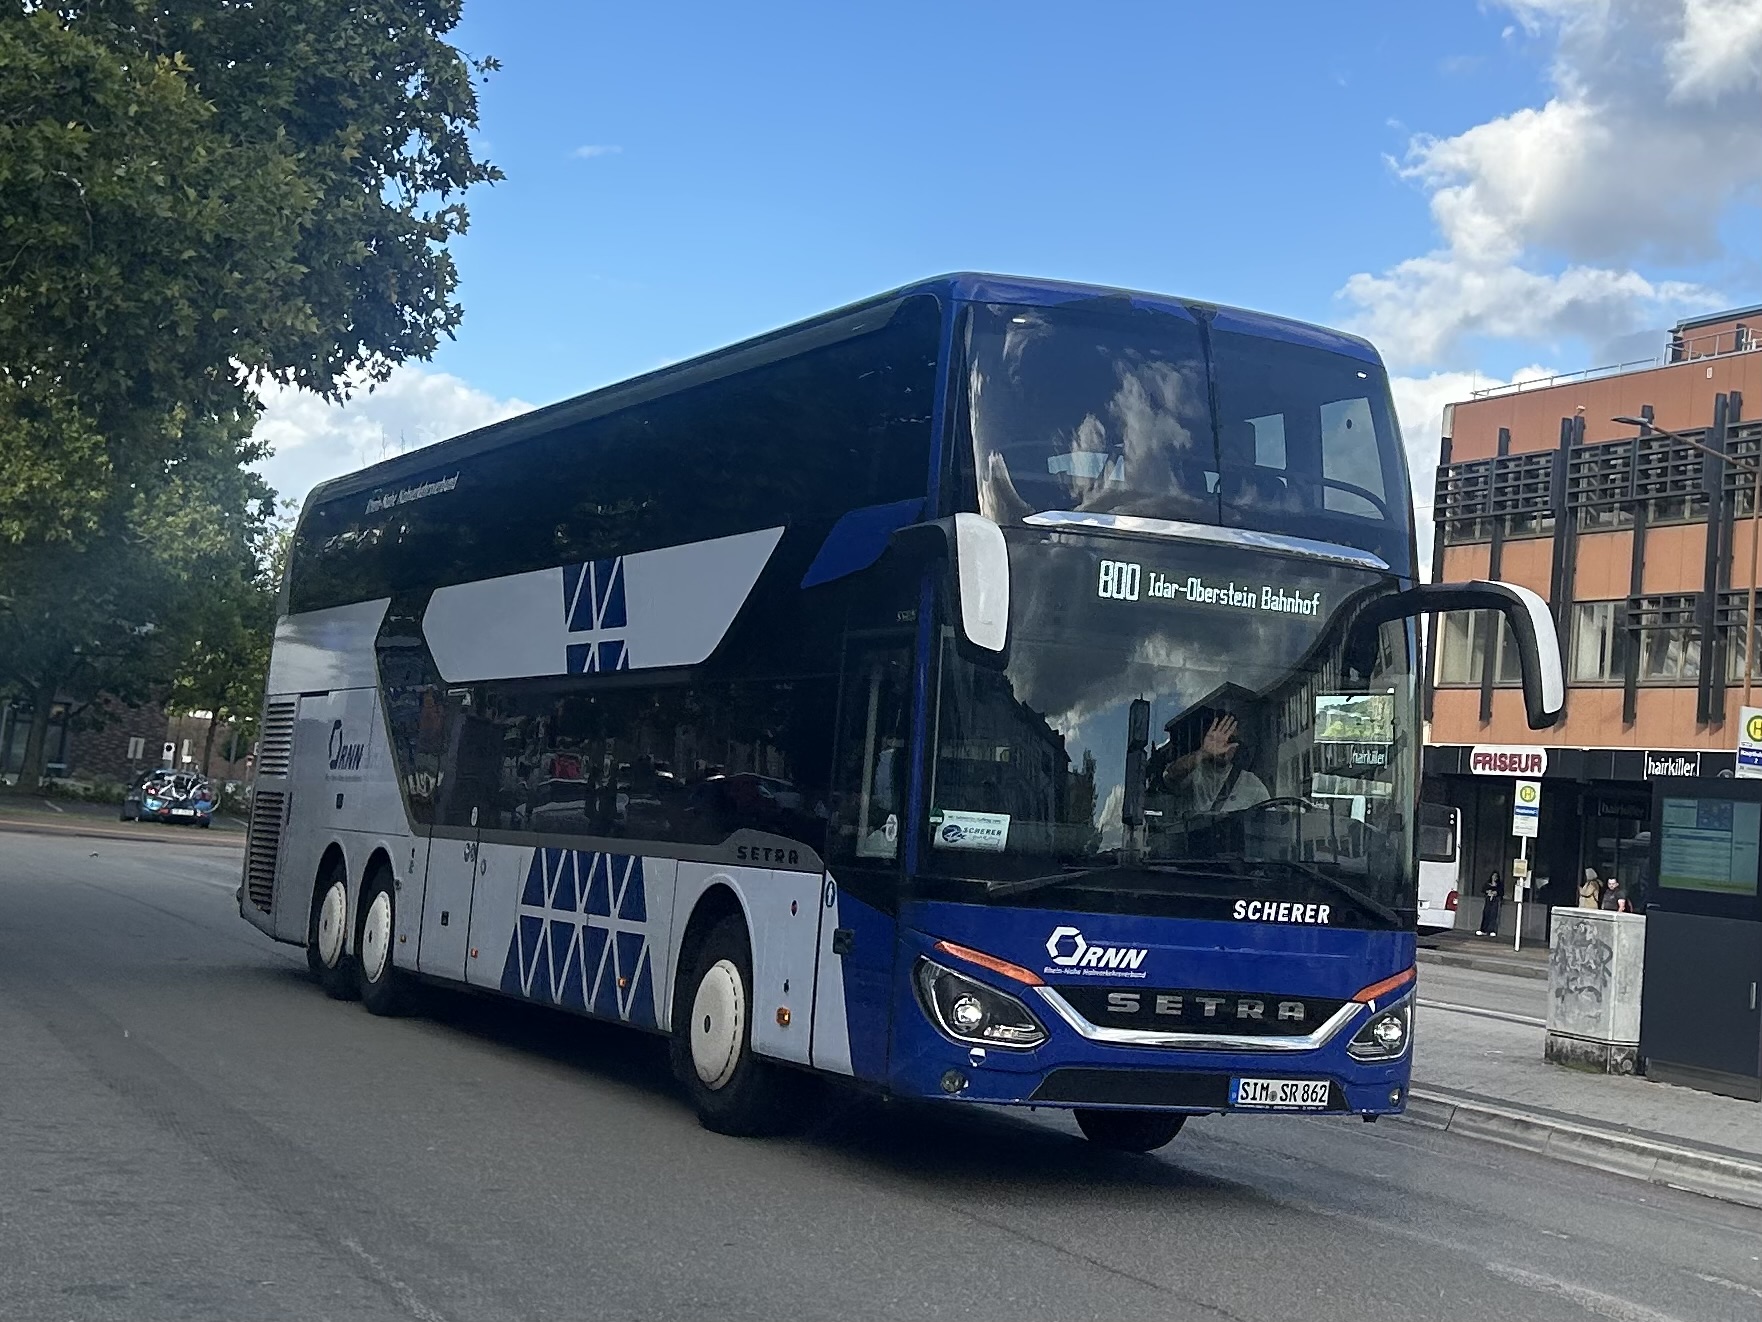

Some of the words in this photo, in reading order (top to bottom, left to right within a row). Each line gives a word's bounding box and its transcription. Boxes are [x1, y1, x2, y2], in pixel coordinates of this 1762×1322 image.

[1098, 560, 1141, 601] 800
[1148, 572, 1256, 609] Idar-Oberstein
[1260, 586, 1321, 616] Bahnhof
[1472, 752, 1543, 774] FRISEUR
[736, 845, 800, 865] SETRA
[1232, 899, 1331, 924] SCHERER
[1106, 992, 1306, 1021] SETRA
[1240, 1081, 1270, 1102] SIM
[1280, 1083, 1299, 1103] SR
[1301, 1083, 1328, 1103] 862
